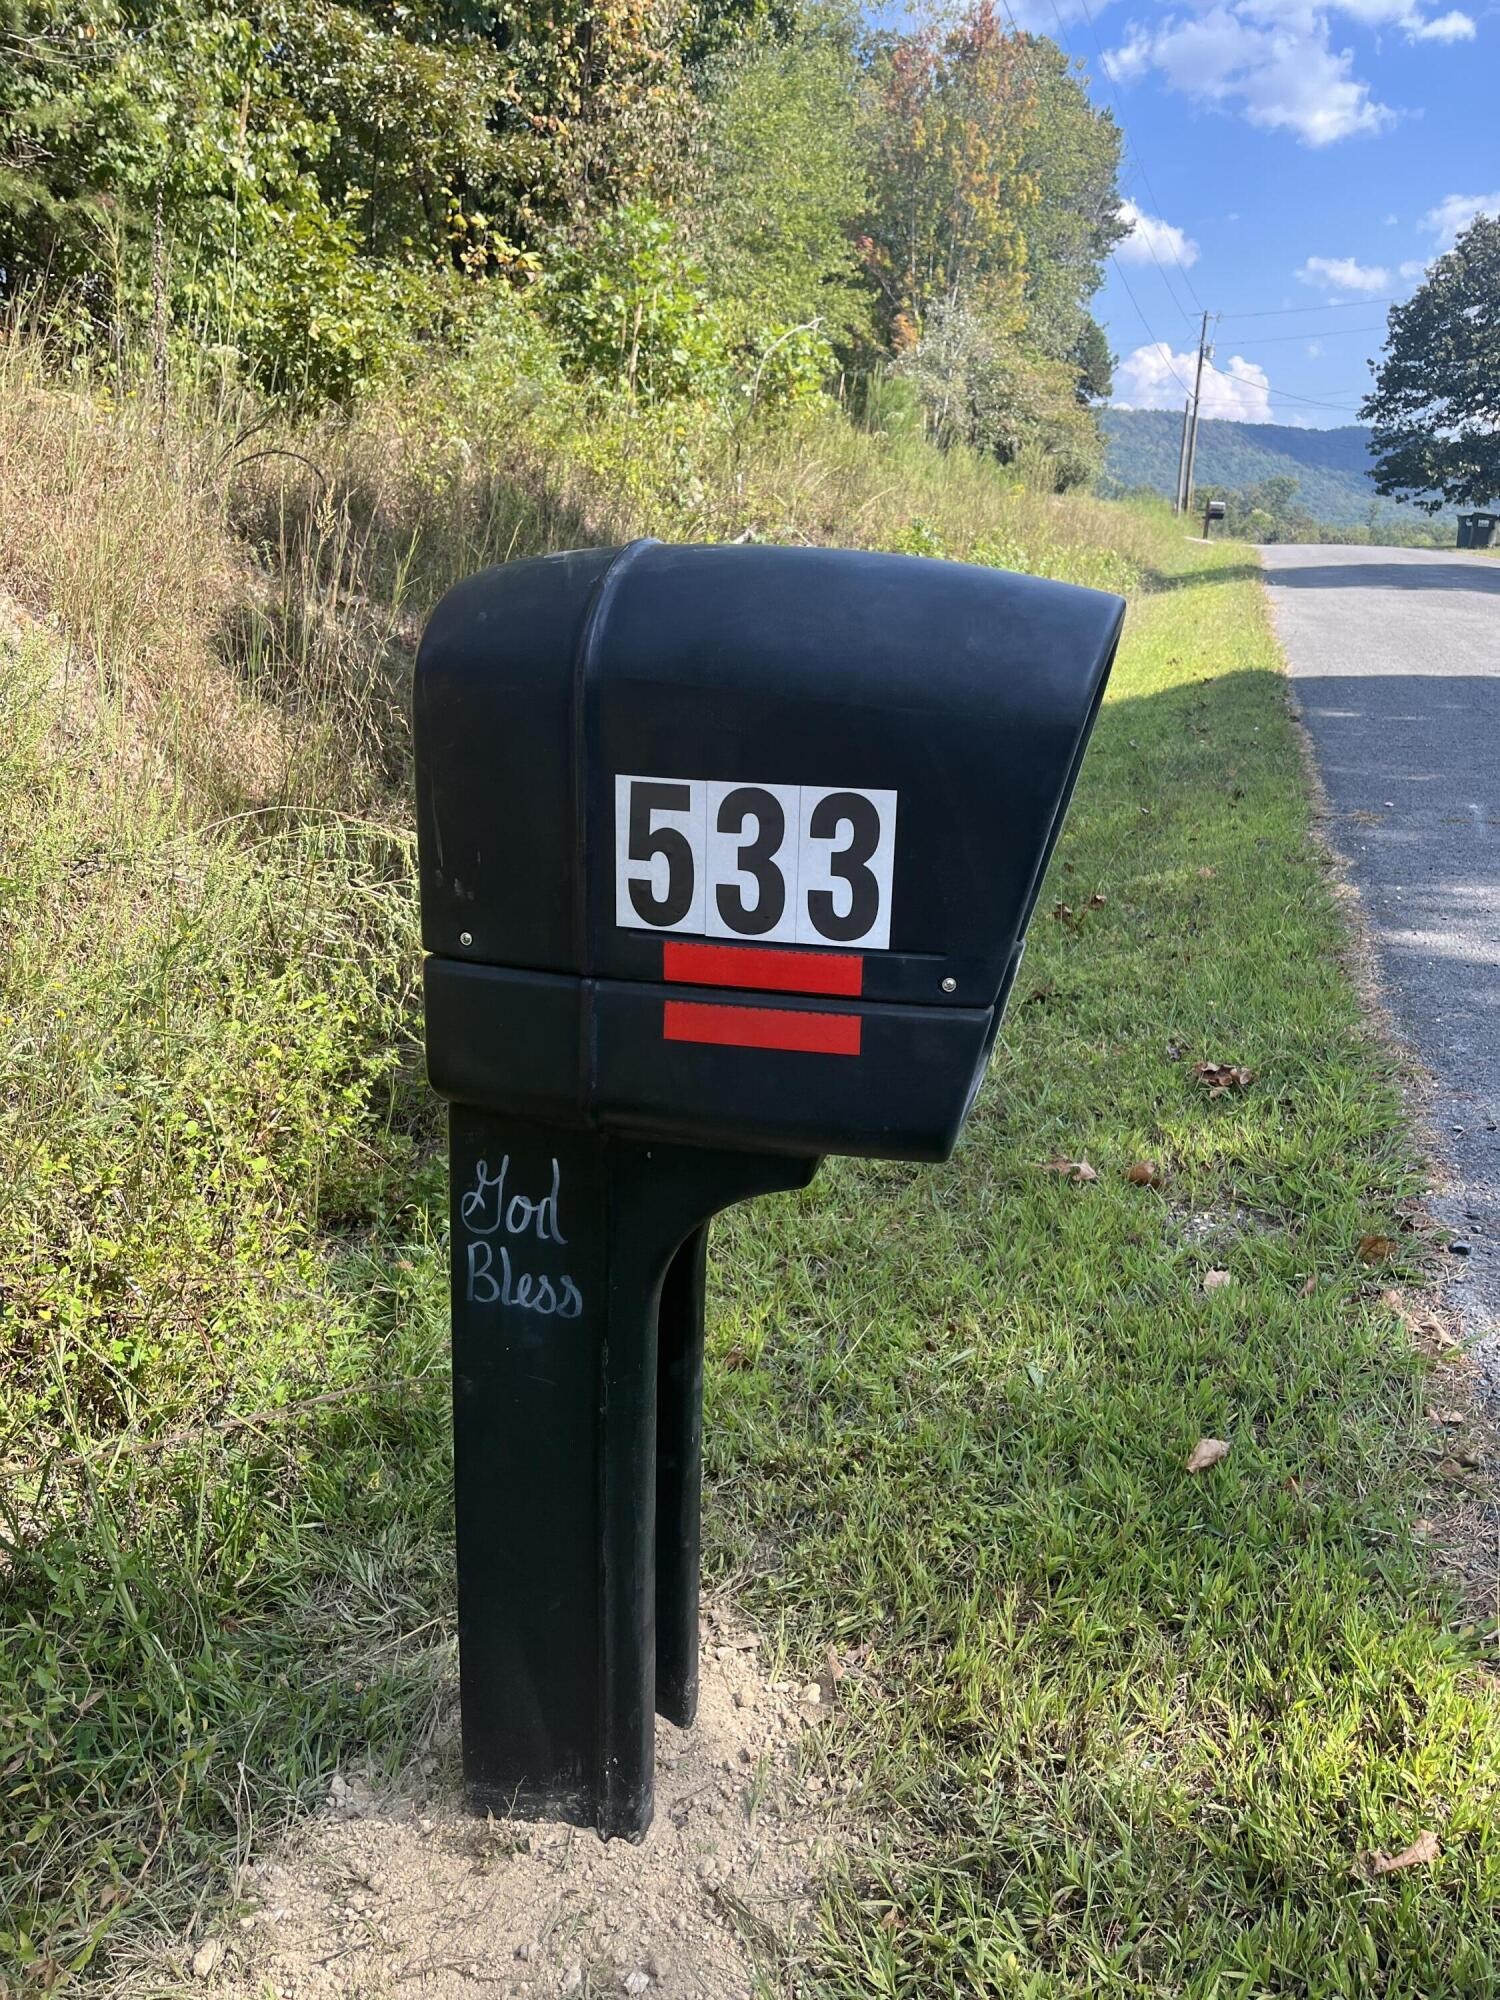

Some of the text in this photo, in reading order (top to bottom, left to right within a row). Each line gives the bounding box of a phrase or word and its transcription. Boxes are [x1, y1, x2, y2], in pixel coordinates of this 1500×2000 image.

[628, 781, 881, 942] 533
[461, 1154, 569, 1245] God
[467, 1240, 583, 1319] Bless
